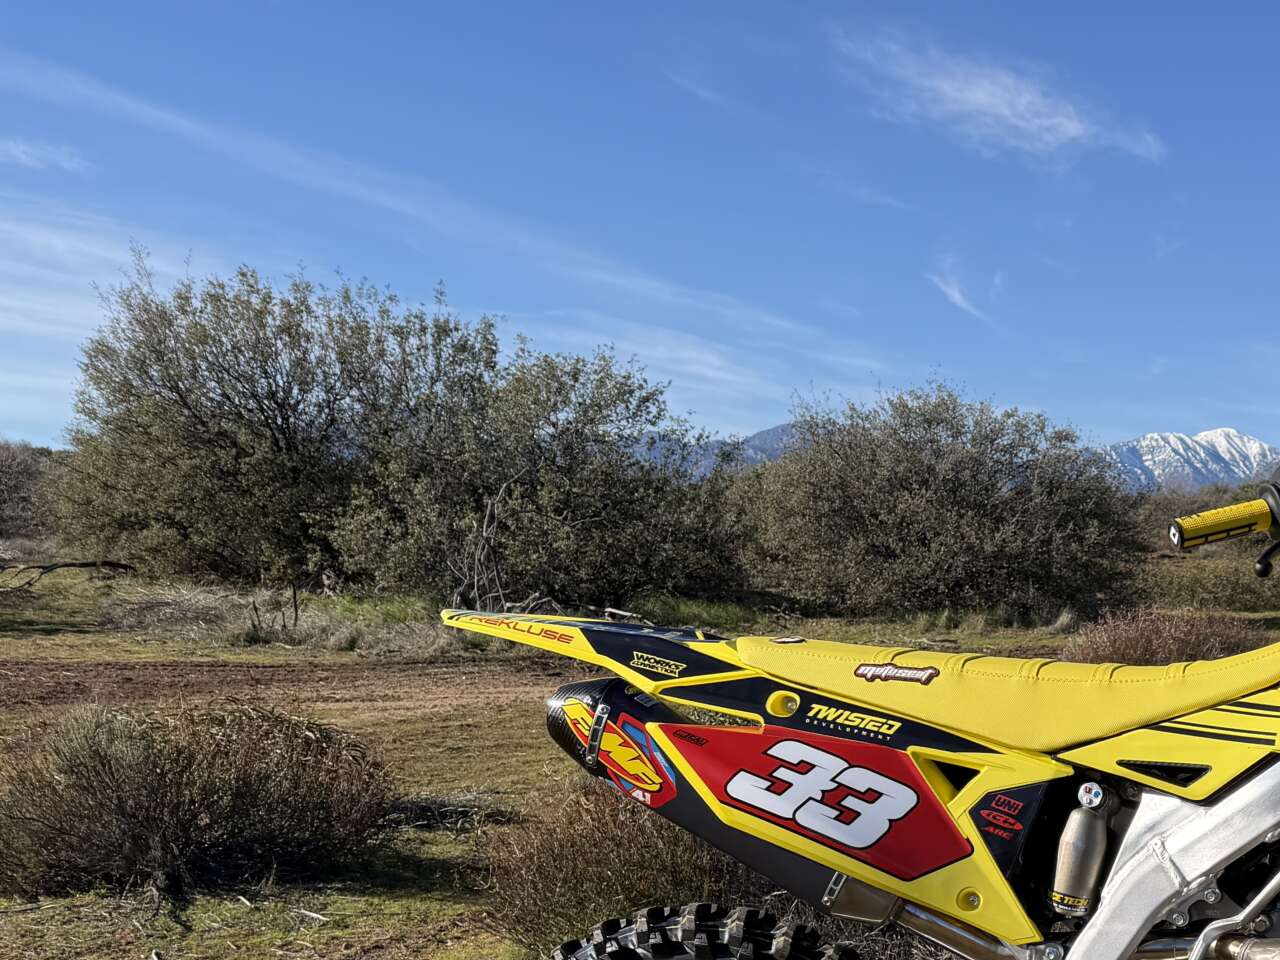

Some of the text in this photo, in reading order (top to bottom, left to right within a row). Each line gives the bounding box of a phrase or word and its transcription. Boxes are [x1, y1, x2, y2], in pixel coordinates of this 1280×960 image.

[470, 616, 575, 645] REKLUSE
[634, 651, 684, 670] WORKS
[805, 718, 891, 741] DEVELOPMENT
[806, 703, 902, 735] TWISTED
[726, 740, 919, 849] 33
[994, 796, 1022, 814] UNI
